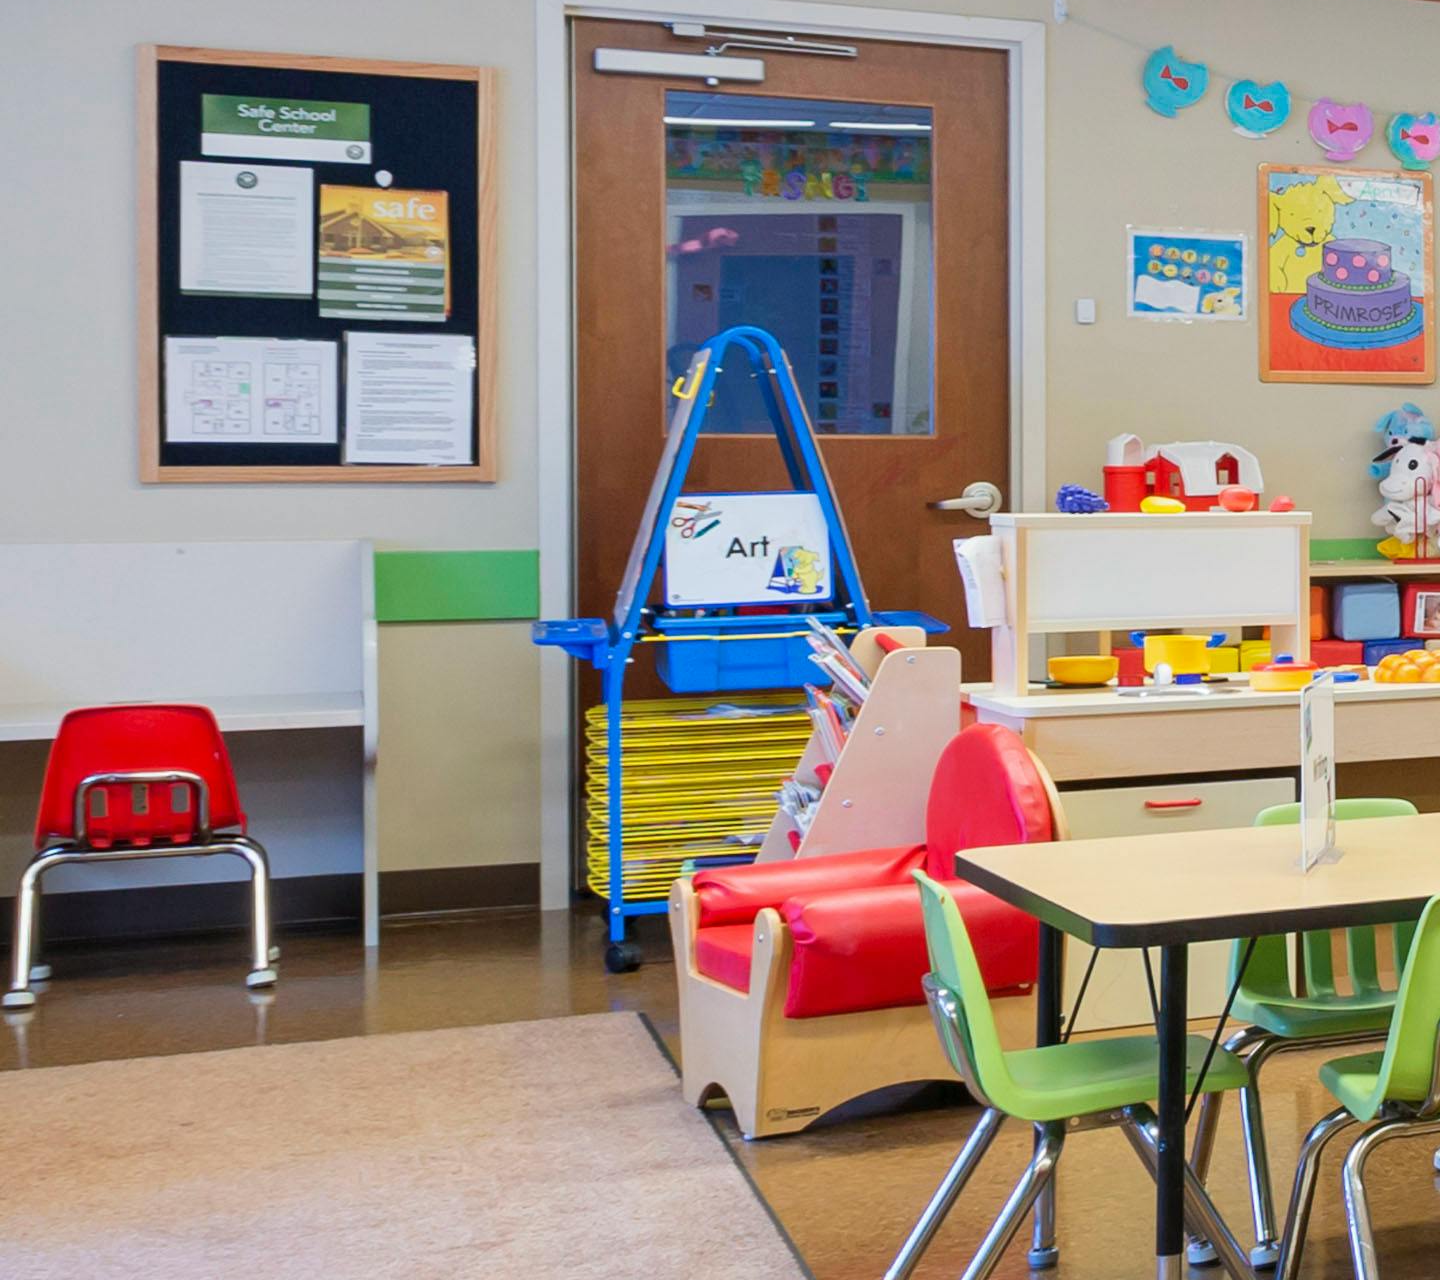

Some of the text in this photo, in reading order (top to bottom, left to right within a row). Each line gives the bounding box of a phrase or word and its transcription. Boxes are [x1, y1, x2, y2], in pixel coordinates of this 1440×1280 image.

[237, 104, 337, 123] Safe School
[258, 118, 317, 135] Center
[372, 197, 436, 220] safe
[726, 536, 770, 559] Art
